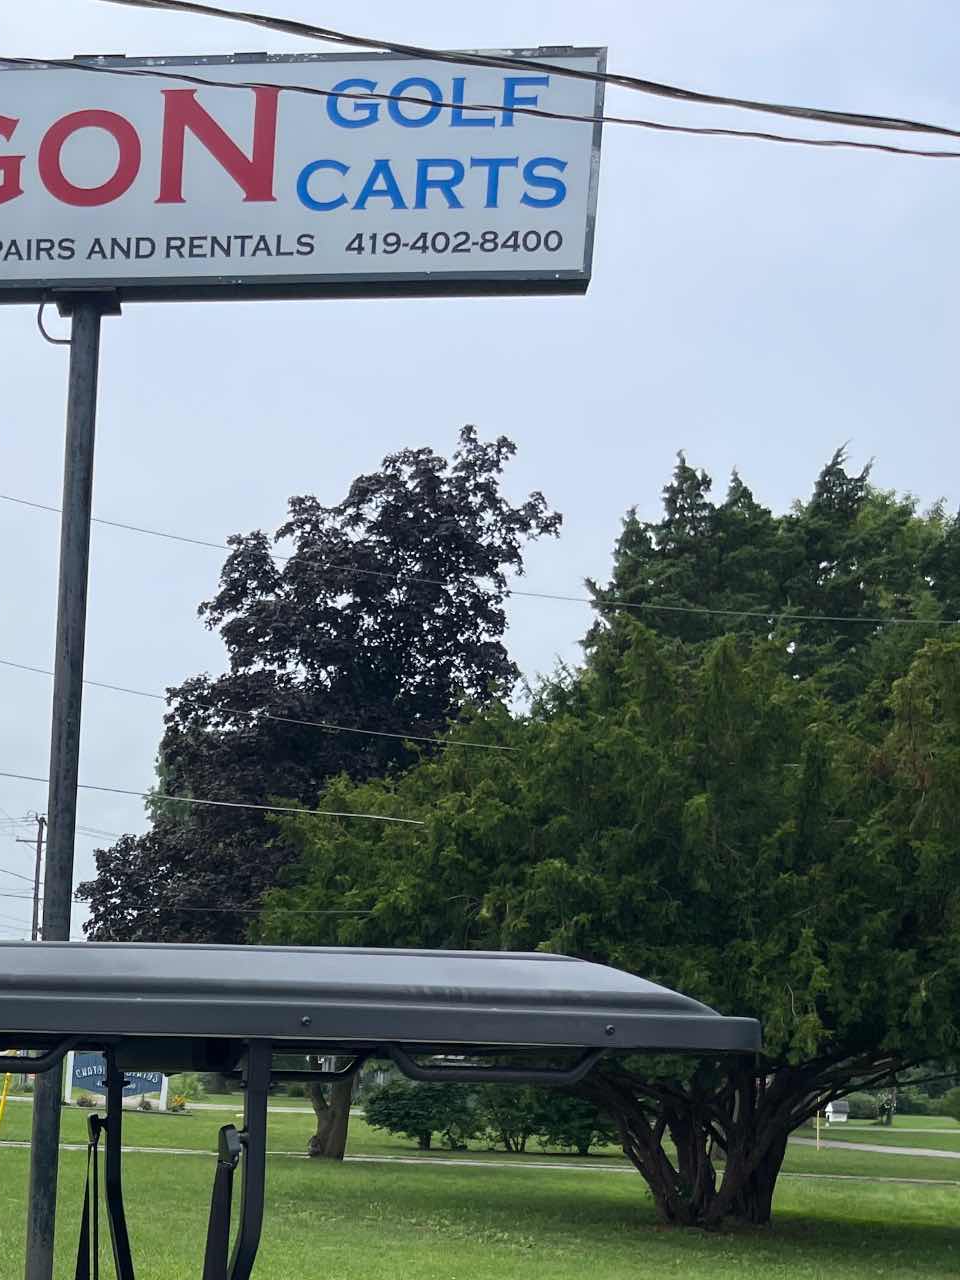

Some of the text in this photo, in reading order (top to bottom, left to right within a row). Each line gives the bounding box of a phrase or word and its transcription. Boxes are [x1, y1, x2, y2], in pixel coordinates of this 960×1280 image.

[326, 75, 551, 129] GOLF
[295, 155, 568, 213] CARTS
[86, 237, 156, 261] AND
[165, 234, 316, 259] RENTALS
[345, 230, 564, 254] 419-402-8400
